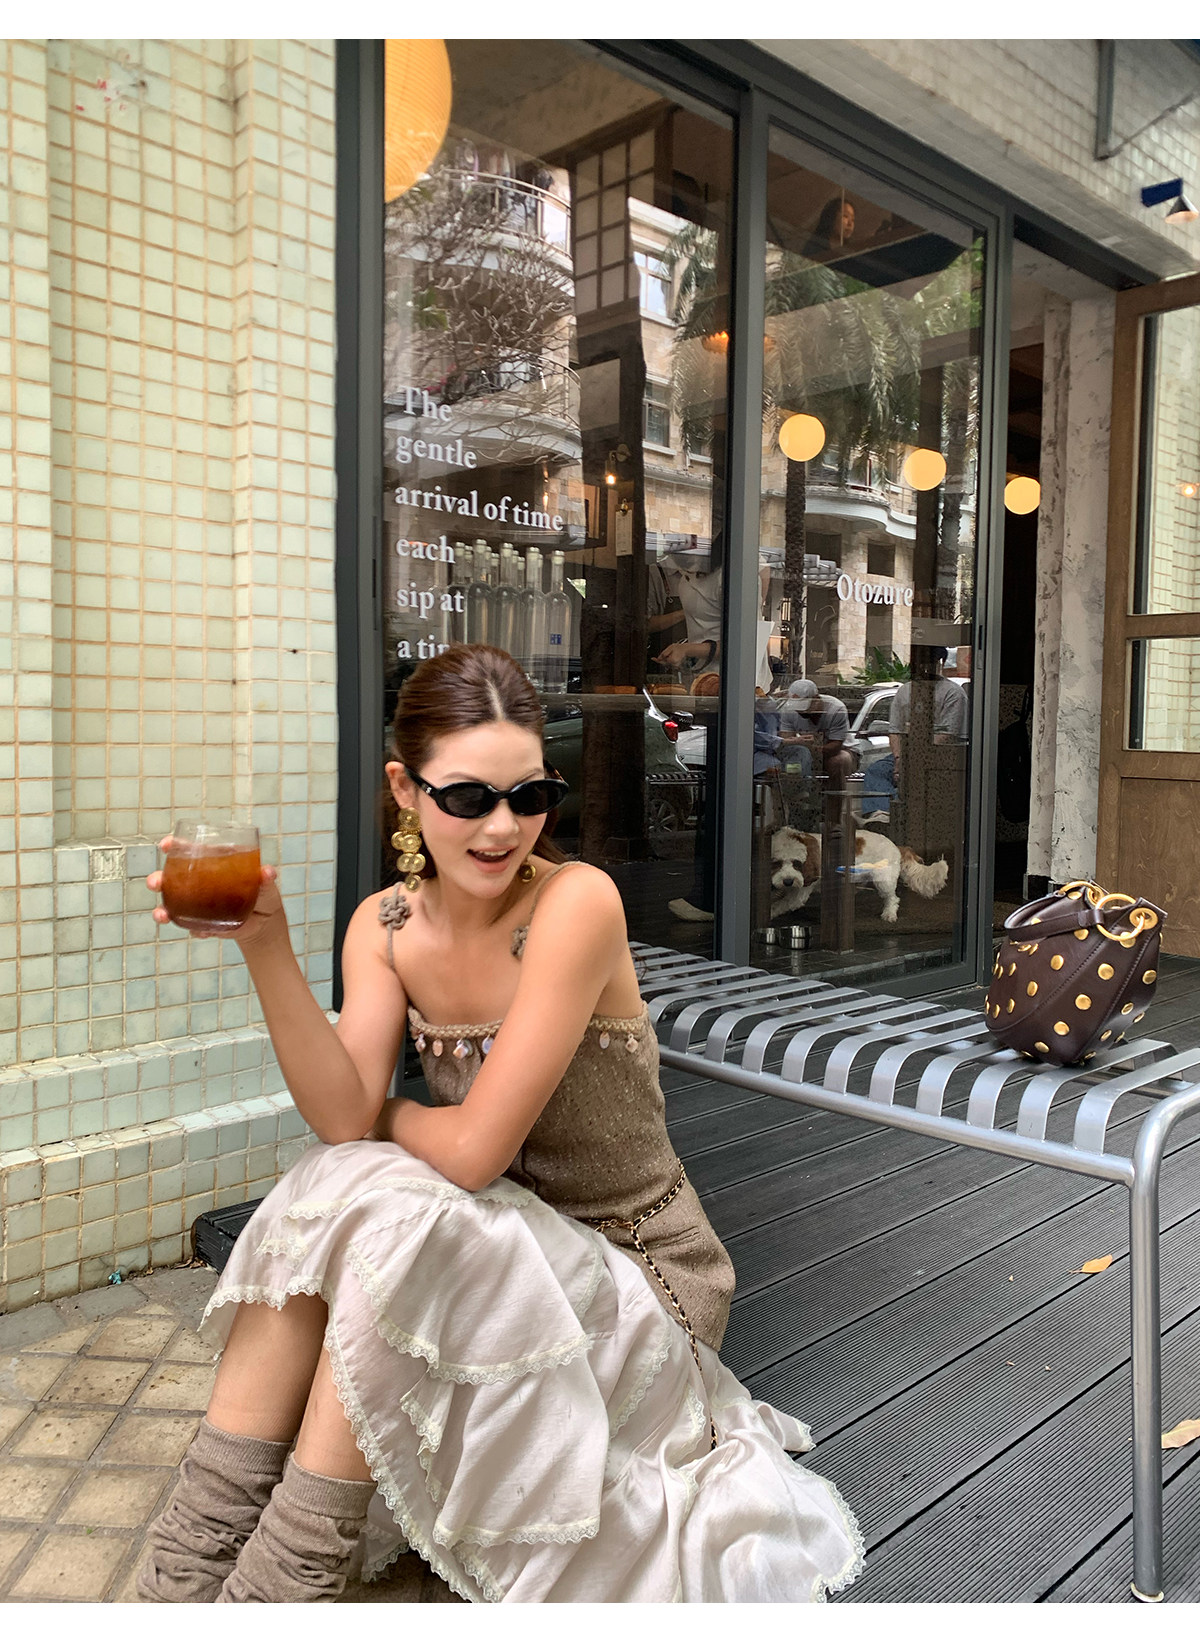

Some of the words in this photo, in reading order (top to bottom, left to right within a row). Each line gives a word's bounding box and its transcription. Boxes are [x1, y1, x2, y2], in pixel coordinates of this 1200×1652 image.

[401, 385, 452, 422] The
[395, 435, 477, 469] gentle
[395, 485, 479, 518] arrival
[483, 496, 512, 523] of
[512, 501, 564, 531] time
[396, 535, 456, 563] each
[396, 582, 434, 619] sip
[440, 591, 465, 613] at
[837, 573, 914, 607] Otozure
[397, 640, 412, 659] a
